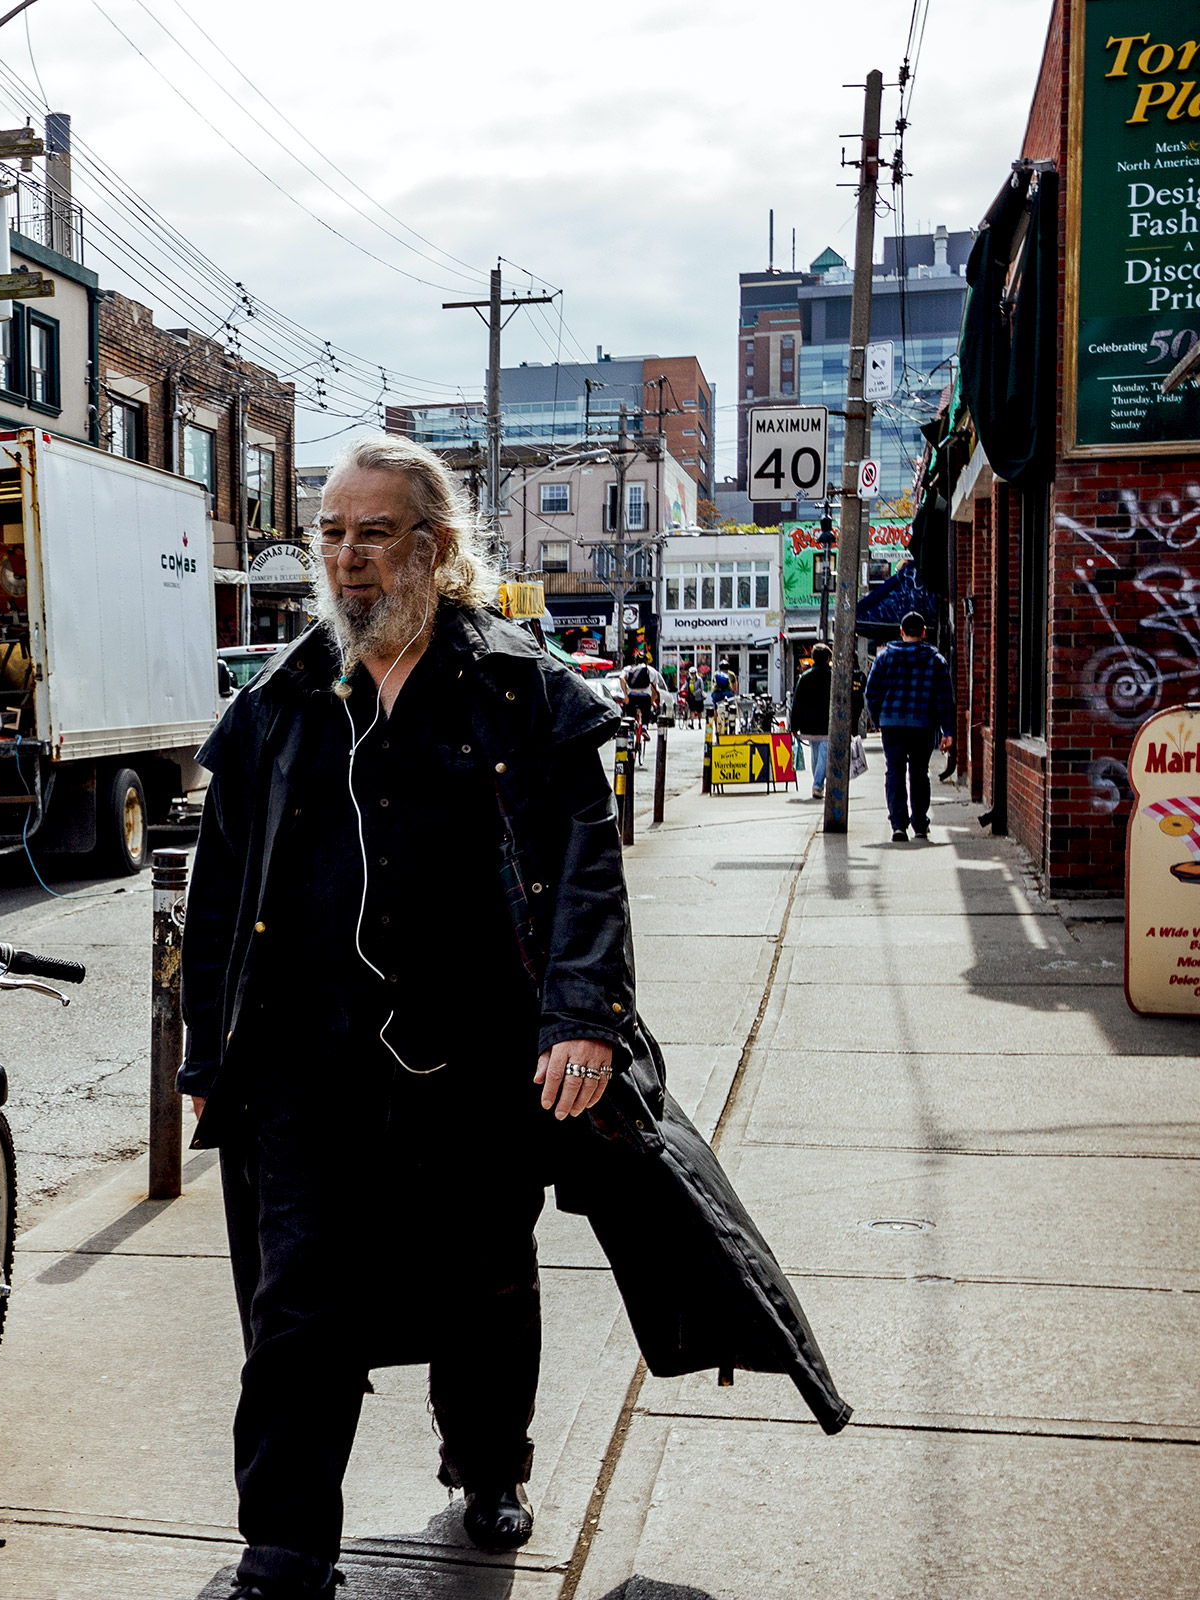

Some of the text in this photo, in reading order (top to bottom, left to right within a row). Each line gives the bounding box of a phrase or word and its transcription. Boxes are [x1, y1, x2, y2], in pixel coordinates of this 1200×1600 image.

[1155, 141, 1187, 153] Men's
[1117, 159, 1150, 172] North
[1127, 177, 1200, 209] Desi
[1148, 283, 1200, 312] Pri
[1088, 341, 1148, 354] Celebrating
[1156, 393, 1184, 404] Friday
[1110, 407, 1147, 418] Saturday
[755, 417, 821, 433] MAXIMUM
[1110, 420, 1141, 431] Sunday
[753, 446, 822, 489] 40
[251, 545, 313, 572] THOMAS LAVERS
[674, 617, 761, 629] longboard living
[713, 760, 748, 769] Warehouse
[718, 768, 741, 780] Sale
[1145, 926, 1156, 937] A
